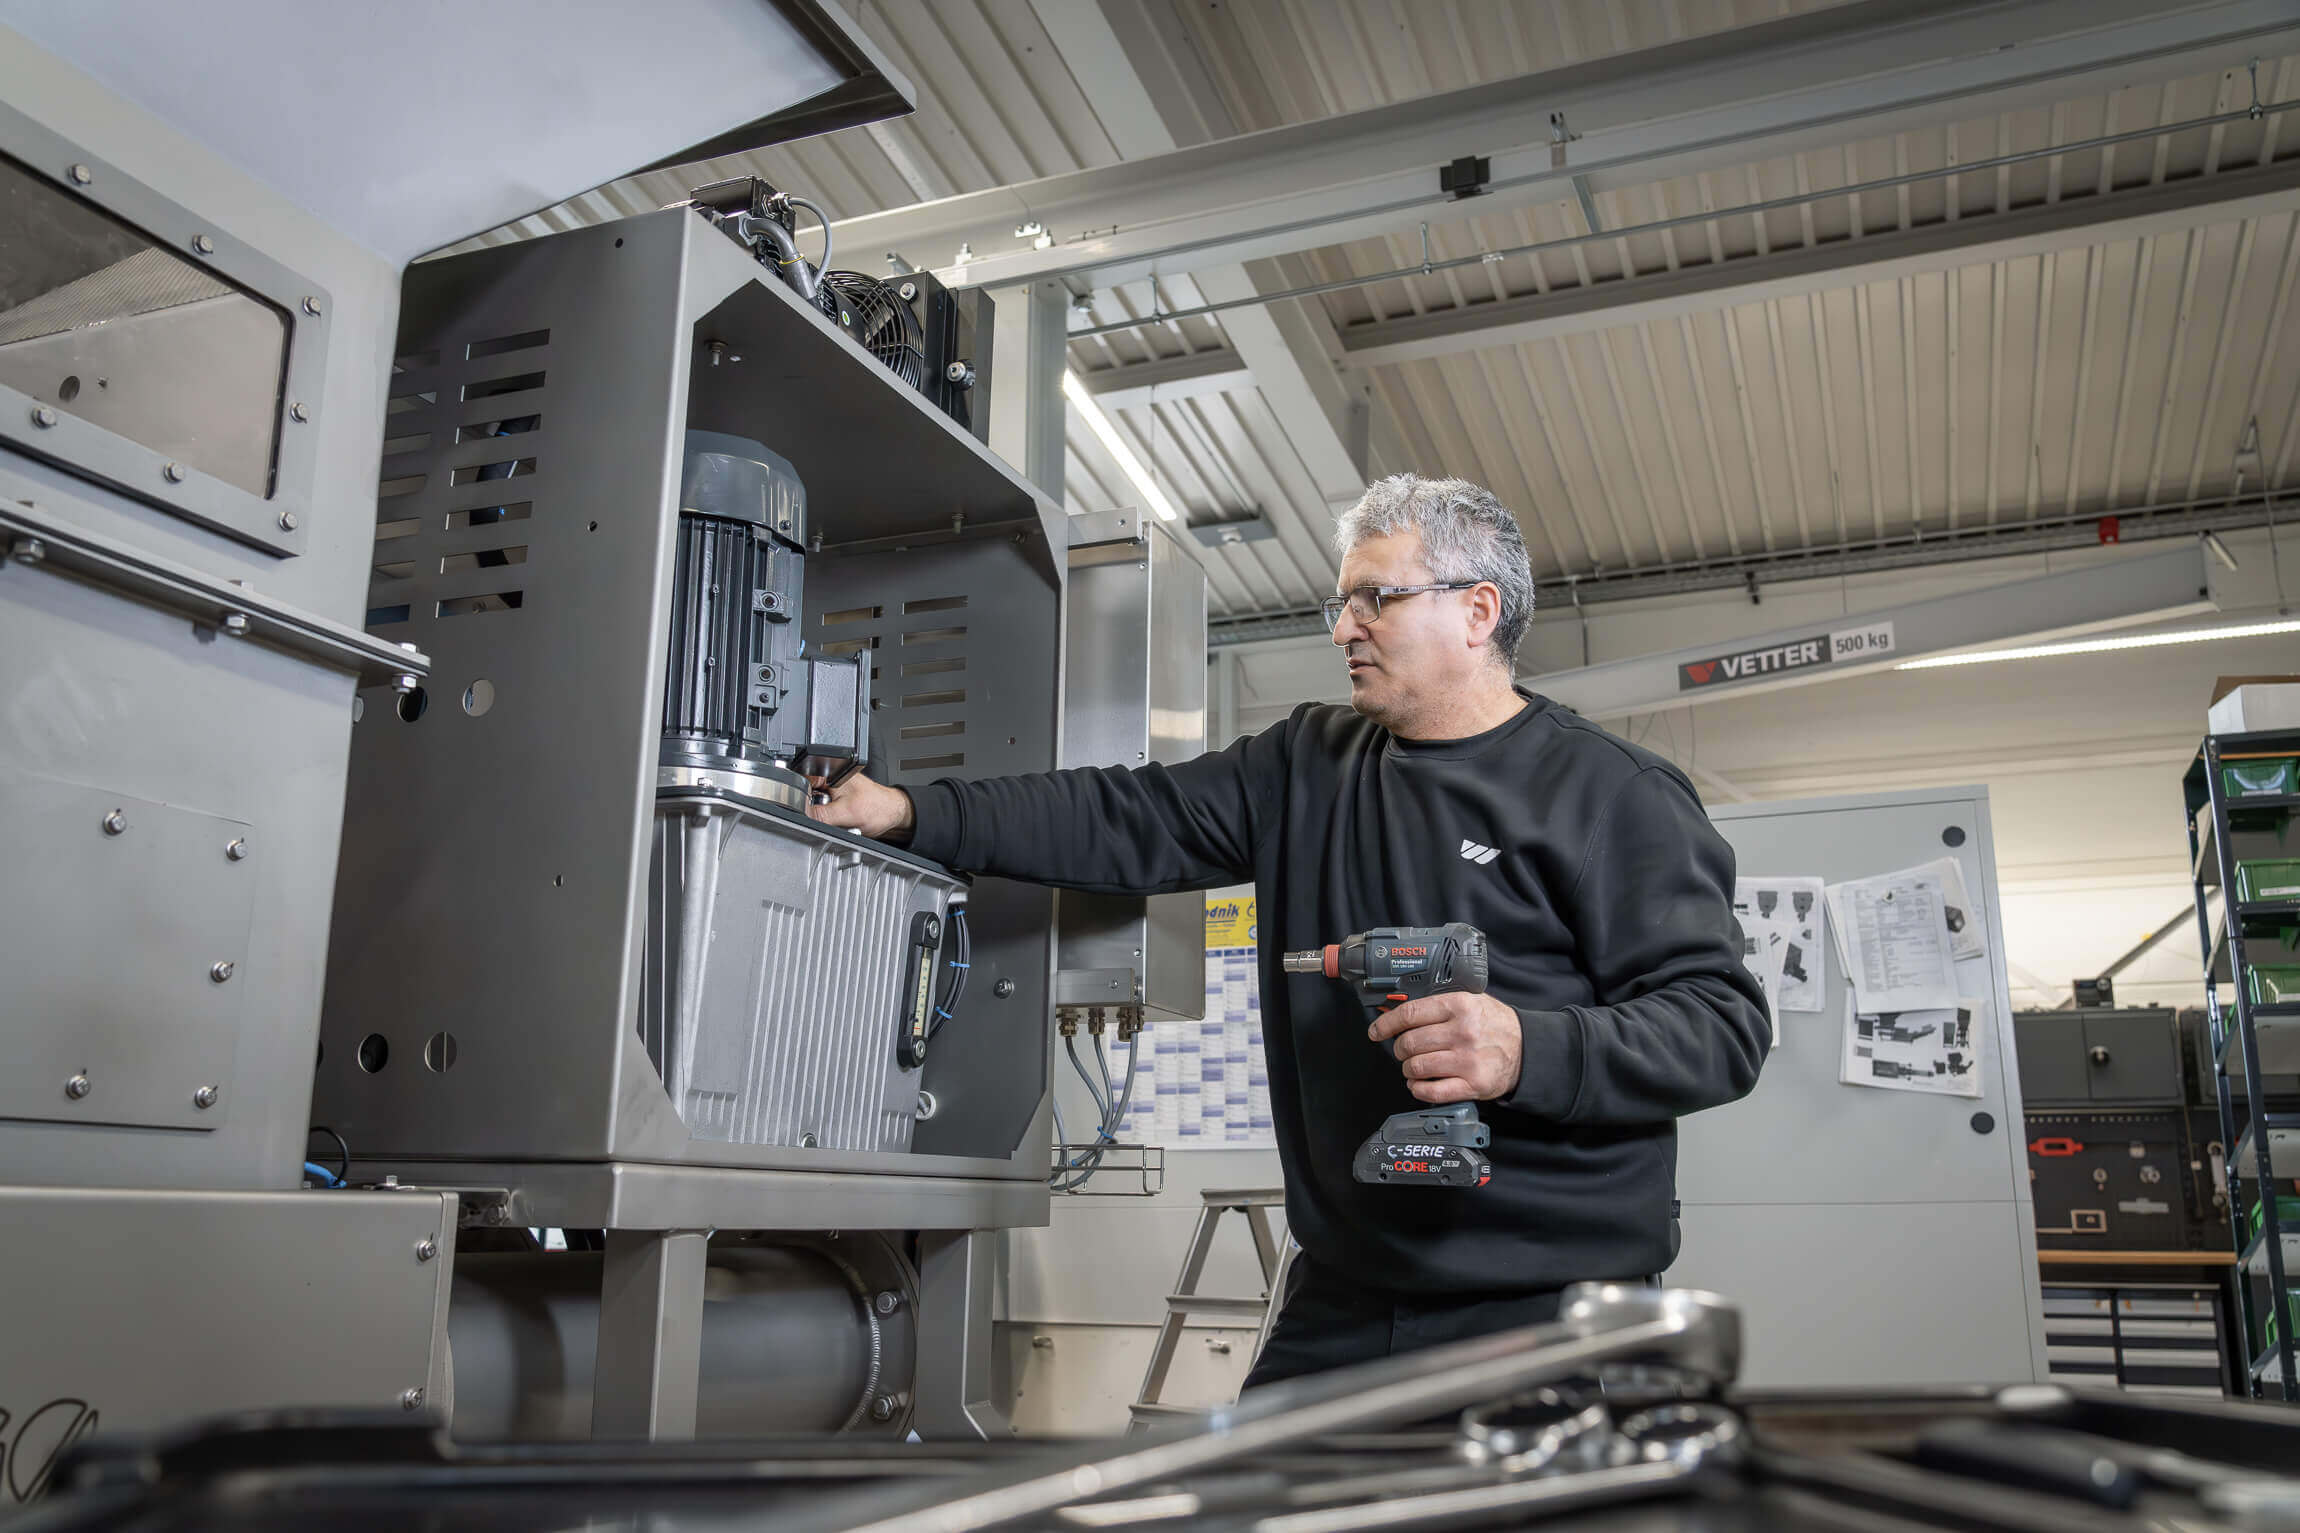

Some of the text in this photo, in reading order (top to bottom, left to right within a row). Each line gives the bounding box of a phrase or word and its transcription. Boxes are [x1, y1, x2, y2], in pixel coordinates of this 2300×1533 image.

[1720, 633, 1889, 678] VETTER 500 kg
[1391, 947, 1427, 956] BOSCH
[1387, 1145, 1445, 1158] C-SERIE
